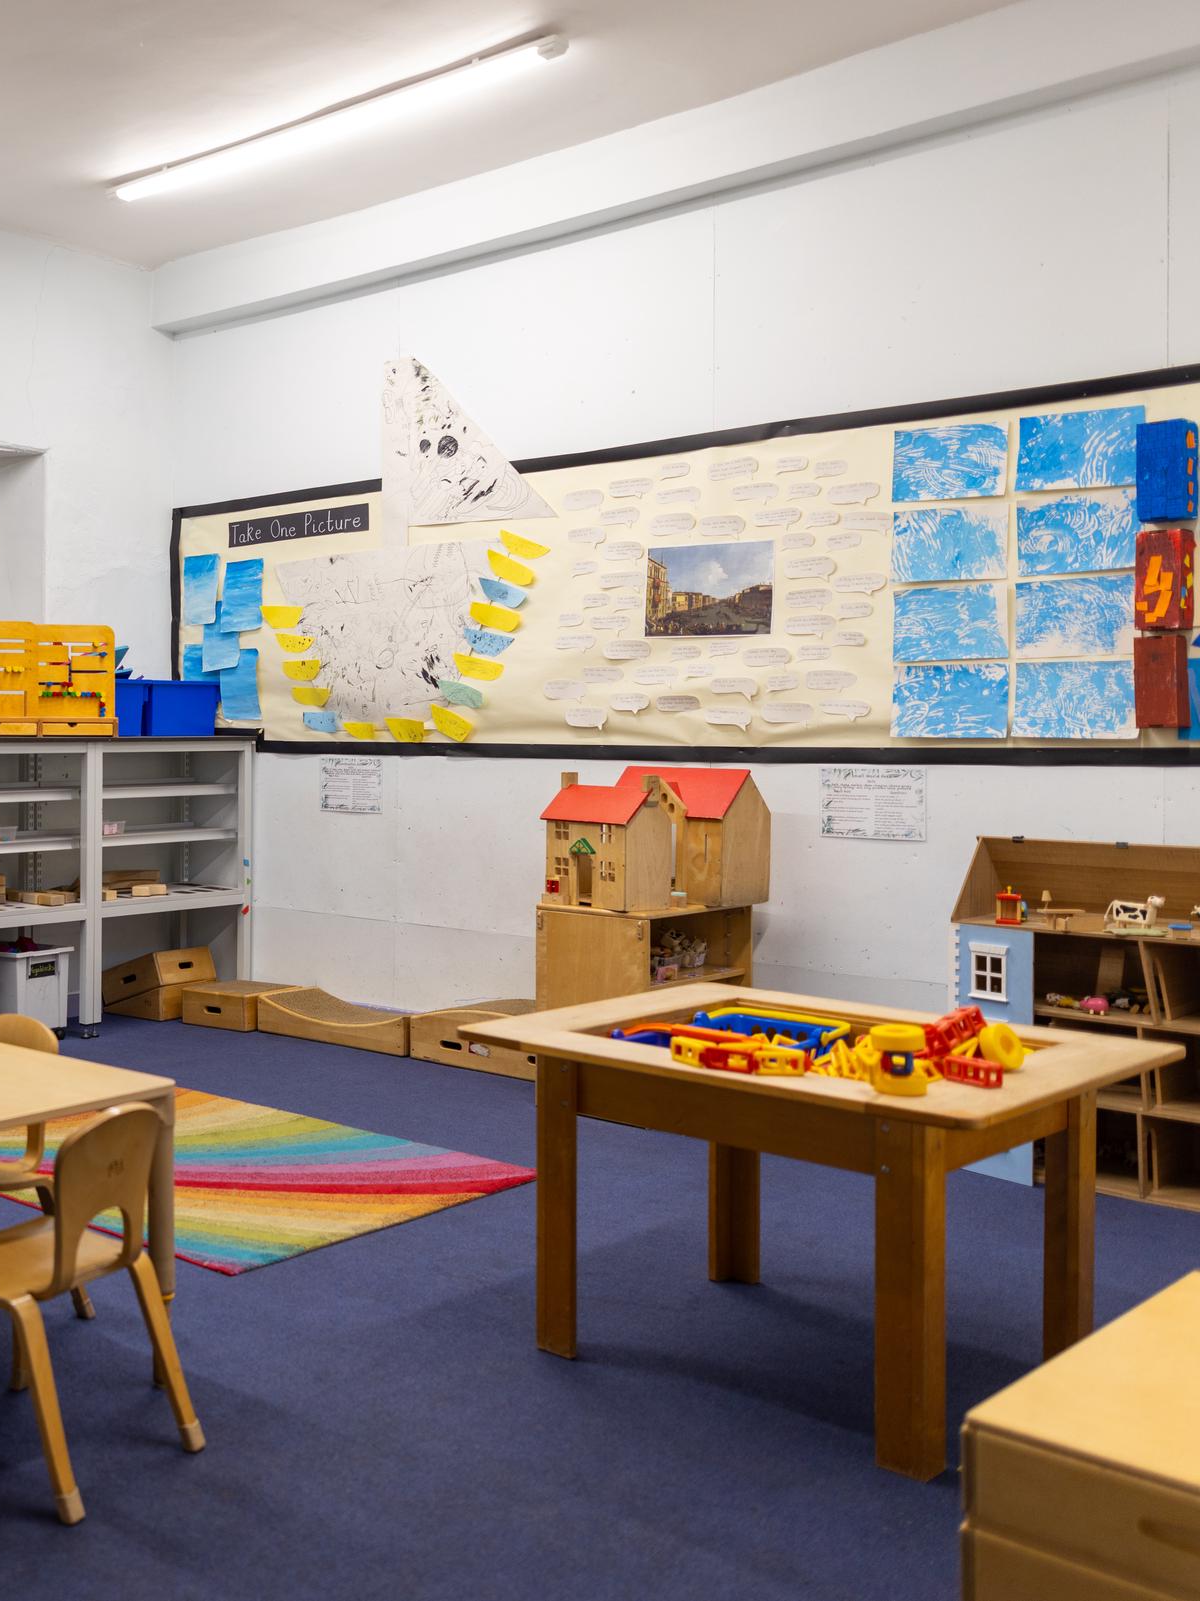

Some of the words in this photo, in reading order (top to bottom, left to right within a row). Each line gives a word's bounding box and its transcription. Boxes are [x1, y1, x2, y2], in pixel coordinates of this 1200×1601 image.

[231, 523, 262, 545] Take
[270, 519, 297, 539] One
[304, 510, 362, 535] Picture
